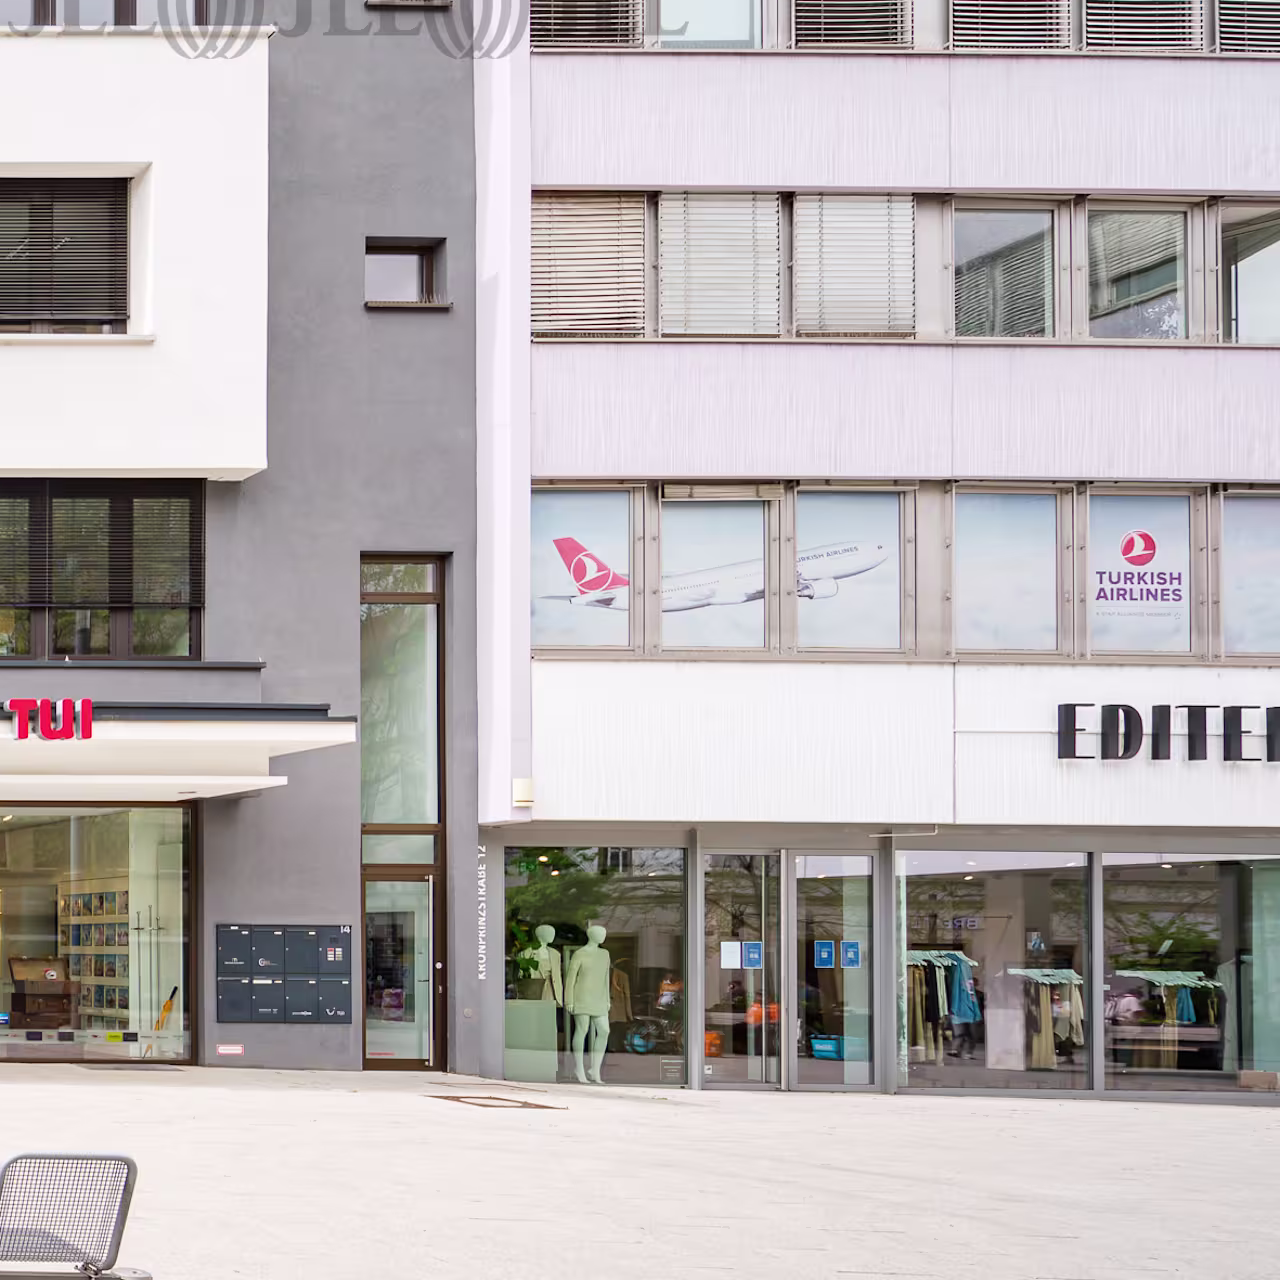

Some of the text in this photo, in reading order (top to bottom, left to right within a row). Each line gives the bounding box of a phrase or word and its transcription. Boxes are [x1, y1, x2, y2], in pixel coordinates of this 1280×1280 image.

[826, 546, 859, 557] AIRLINES
[1095, 571, 1182, 585] TURKISH
[1095, 587, 1182, 602] AIRLINES
[4, 698, 93, 740] TUI
[340, 925, 351, 934] 14
